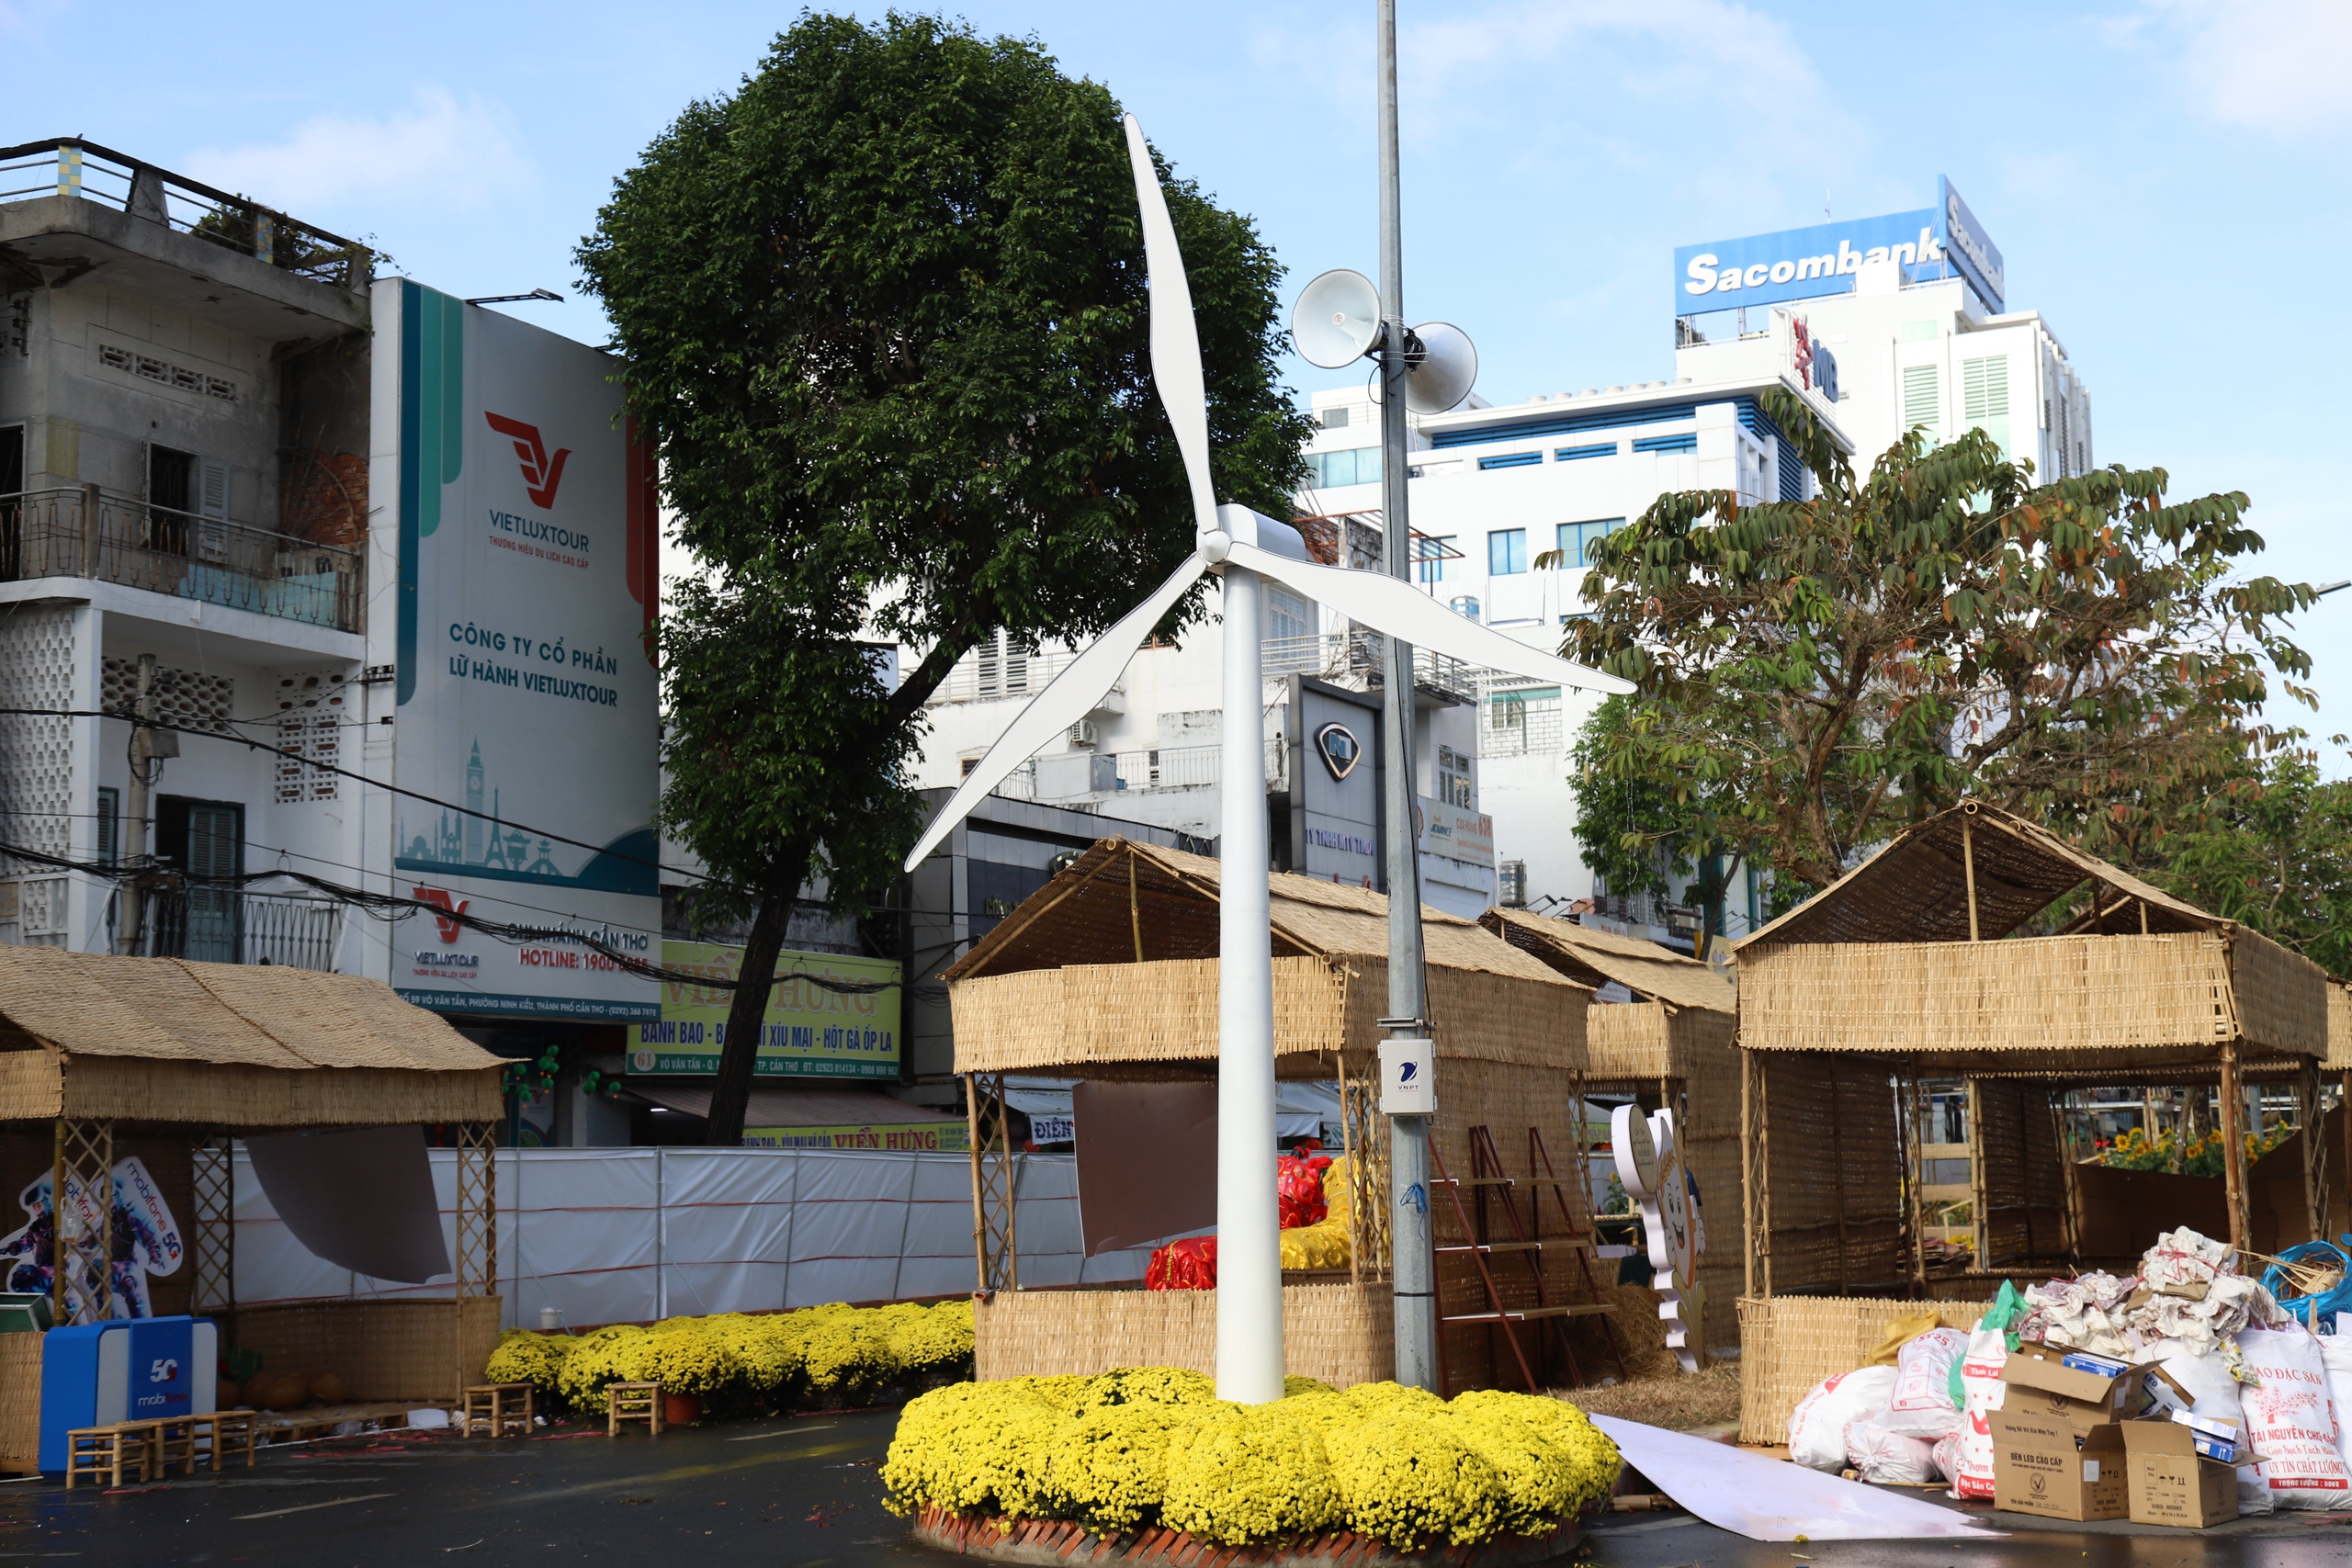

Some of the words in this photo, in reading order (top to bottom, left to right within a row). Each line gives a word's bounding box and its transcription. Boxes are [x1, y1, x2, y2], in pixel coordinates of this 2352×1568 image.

[1684, 227, 1941, 296] Sacombank
[489, 509, 590, 553] VIETLUXTOUR
[489, 536, 516, 551] THƯƠNG
[517, 542, 533, 556] HIỆU
[535, 547, 545, 558] DU
[546, 551, 561, 563] LỊCH
[561, 555, 575, 566] CAO
[576, 558, 590, 570] CẤP
[449, 622, 506, 651] CÔNG
[513, 636, 532, 657] TY
[538, 637, 565, 664] CỔ
[572, 647, 616, 675] PHẦN
[449, 653, 469, 677] LỮ
[472, 659, 519, 688] HÀNH
[523, 671, 617, 707] VIETLUXTOUR
[1430, 823, 1453, 837] ADVANCE
[1478, 816, 1492, 838] 63B
[1316, 829, 1338, 849] TNHH
[1338, 833, 1354, 852] MTV
[589, 919, 619, 949] CẦN
[621, 928, 649, 950] THƠ
[413, 951, 480, 967] VIETLUXTOUR
[519, 948, 580, 969] HOTLINE:
[582, 953, 615, 972] 1900
[662, 951, 741, 1007] VIỄ
[411, 995, 420, 1003] 59
[421, 993, 433, 1005] VÕ
[434, 995, 450, 1006] VĂN
[469, 996, 499, 1009] PHƯỜNG
[500, 998, 517, 1010] NINH
[537, 1000, 559, 1011] THÀNH
[560, 1000, 575, 1013] PHỐ
[592, 1003, 605, 1014] THƠ
[680, 1021, 704, 1044] BAO
[770, 1021, 788, 1047] XÍU
[792, 1026, 812, 1053] MẠI
[824, 1024, 843, 1053] HỘT
[847, 1026, 860, 1050] GÀ
[864, 1024, 876, 1051] ỐP
[880, 1032, 892, 1052] LA
[637, 1053, 652, 1068] 61
[660, 1058, 670, 1070] VÕ
[672, 1058, 685, 1070] VĂN
[758, 1061, 768, 1072] TP.
[785, 1061, 797, 1072] THƠ
[803, 1063, 814, 1073] ĐT:
[835, 1064, 855, 1073] 814134
[833, 1127, 880, 1148] VIỄN
[886, 1129, 937, 1150] HƯNG
[1035, 1117, 1071, 1142] ĐIỆN
[127, 1162, 167, 1232] mobifone
[162, 1232, 182, 1260] 5G
[1917, 1332, 1950, 1347] ST25
[150, 1359, 178, 1383] 5G
[2249, 1366, 2273, 1380] ẠO
[2275, 1367, 2301, 1382] ĐẶC
[2302, 1369, 2323, 1386] SẢN
[138, 1392, 188, 1406] mobifone
[2252, 1429, 2266, 1444] TÀI
[2267, 1425, 2305, 1440] NGUYÊN
[2306, 1429, 2323, 1443] CHỢ
[2010, 1451, 2022, 1461] ĐÈN
[2023, 1454, 2035, 1463] LED
[2036, 1456, 2049, 1465] CAO
[2050, 1456, 2063, 1467] CẤP
[2268, 1461, 2279, 1473] UY
[2280, 1458, 2295, 1473] TÍN
[2297, 1456, 2317, 1473] CHẤT
[2318, 1459, 2344, 1477] LƯỢNG
[1961, 1478, 1971, 1489] Đặc
[1972, 1480, 1984, 1490] Sản
[1985, 1482, 1995, 1491] Ca
[2278, 1479, 2299, 1487] TRỌNG
[2300, 1479, 2319, 1488] LƯỢNG
